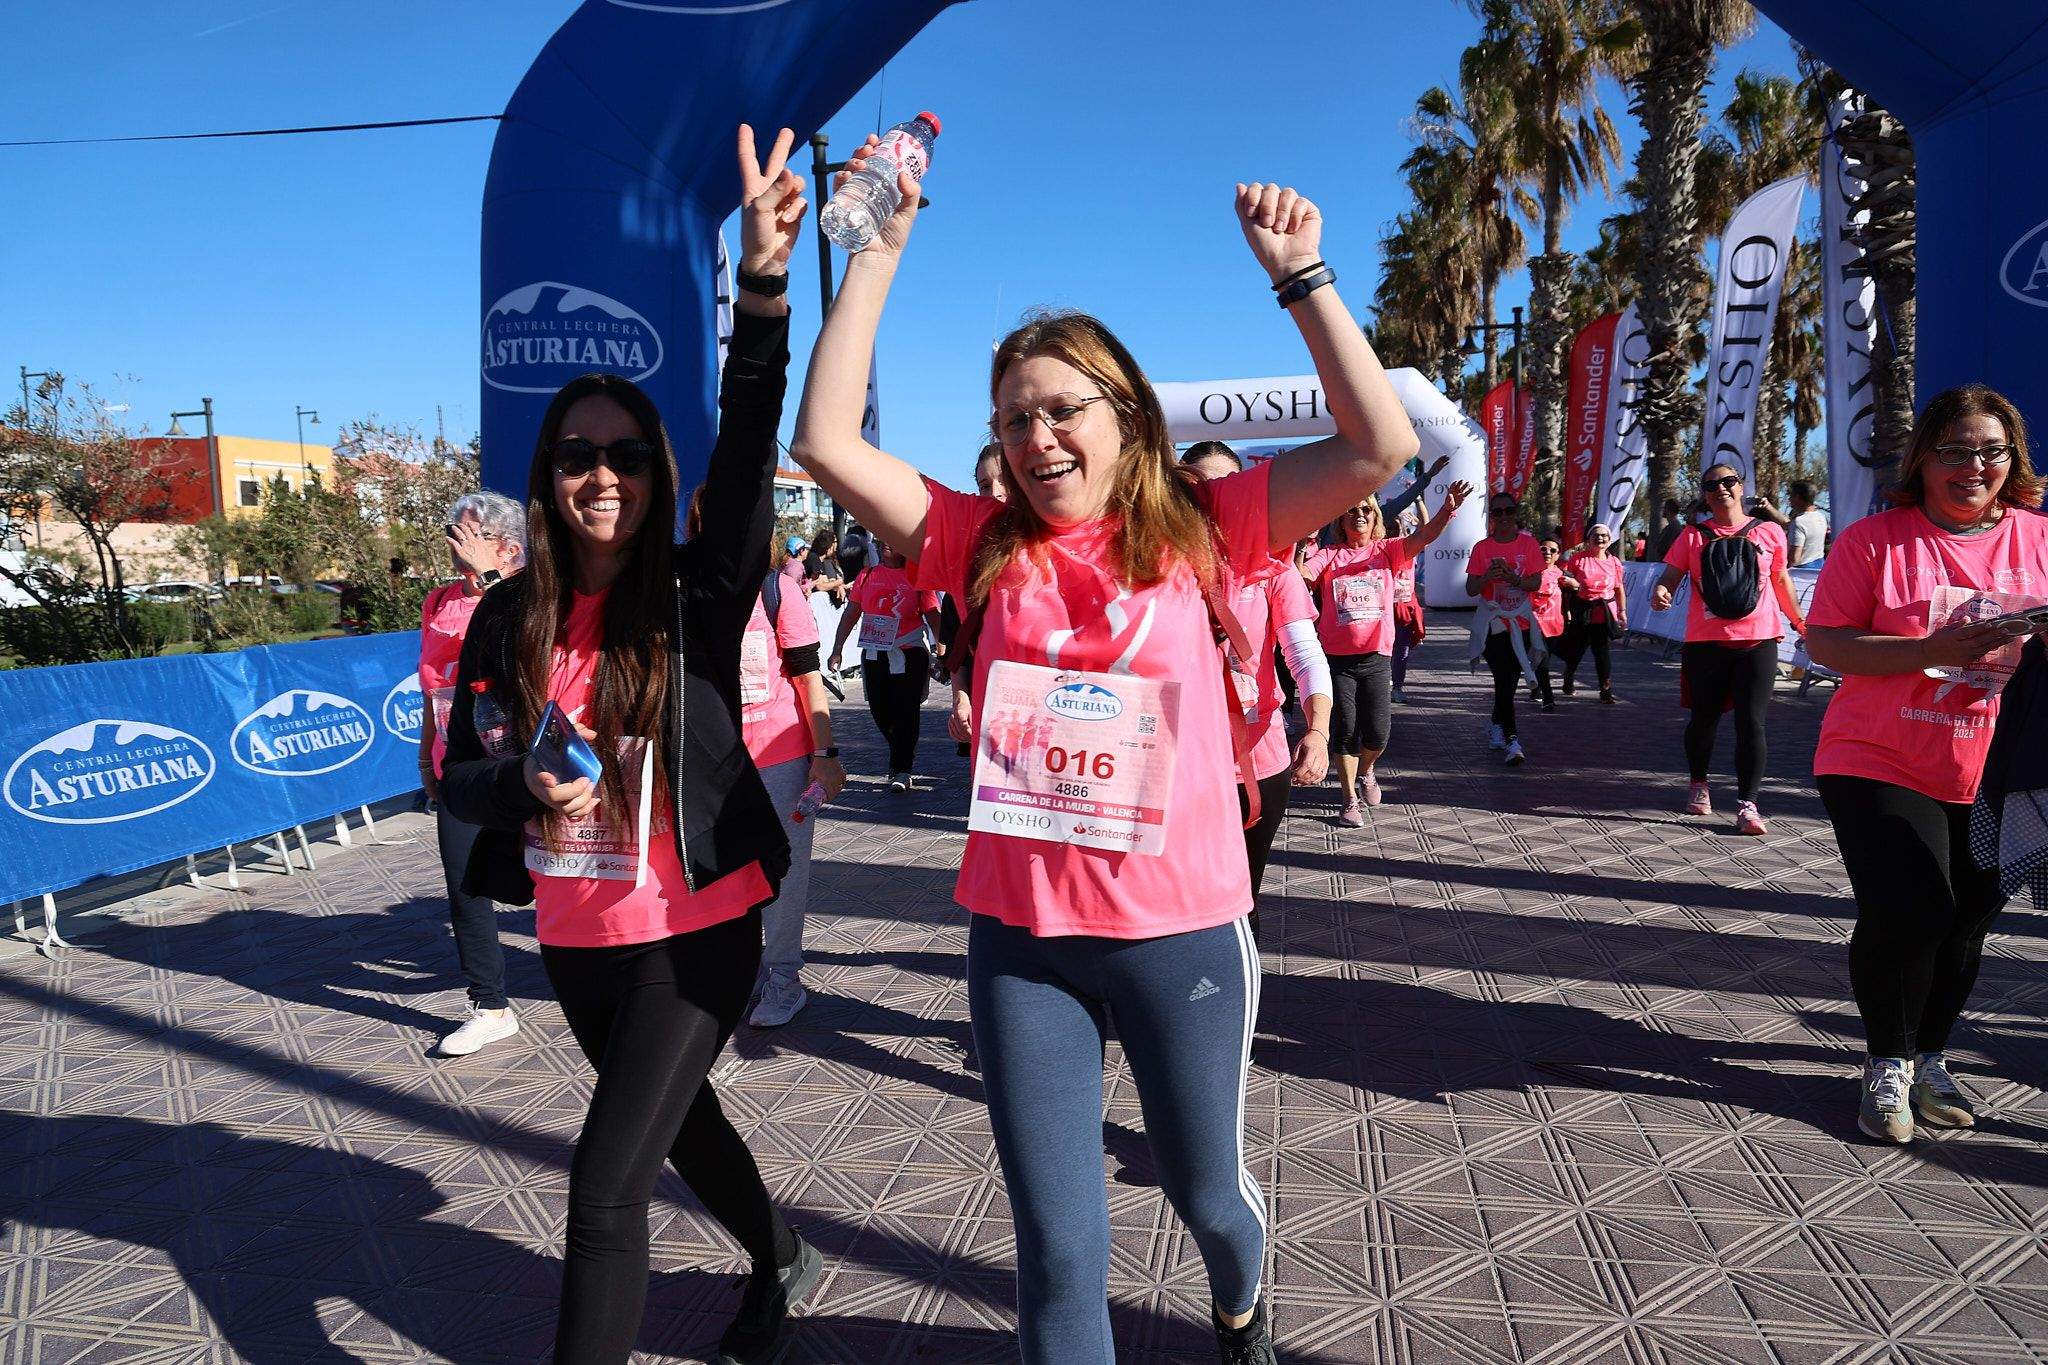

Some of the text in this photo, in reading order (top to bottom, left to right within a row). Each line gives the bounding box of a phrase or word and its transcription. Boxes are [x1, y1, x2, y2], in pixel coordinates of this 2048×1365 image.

[498, 320, 640, 336] CENTRAL LECHERA
[484, 328, 648, 369] ASTURIANA
[1577, 344, 1607, 445] Santander
[1199, 389, 1334, 425] OYSH
[1493, 404, 1506, 475] Santander
[1434, 549, 1471, 560] OYSH
[1050, 694, 1117, 715] ASTURIANA
[1900, 706, 1951, 726] CARRERA
[1953, 715, 1968, 727] DE
[1972, 716, 1985, 728] LA
[250, 720, 369, 765] ASTURIANA
[1953, 728, 1975, 739] 2025
[53, 742, 190, 772] CENTRAL LECHERA
[1044, 746, 1116, 780] 016
[28, 754, 206, 810] ASTURIANA
[1055, 782, 1089, 798] 4886
[998, 791, 1038, 806] CARRERA
[1039, 797, 1052, 807] DE
[1053, 798, 1064, 809] LA
[1065, 800, 1096, 814] MUJER
[1103, 806, 1144, 820] VALENCIA
[992, 810, 1052, 830] OYSHO
[577, 829, 607, 841] 4887
[1087, 825, 1144, 843] Santander
[533, 854, 578, 870] OYSHO
